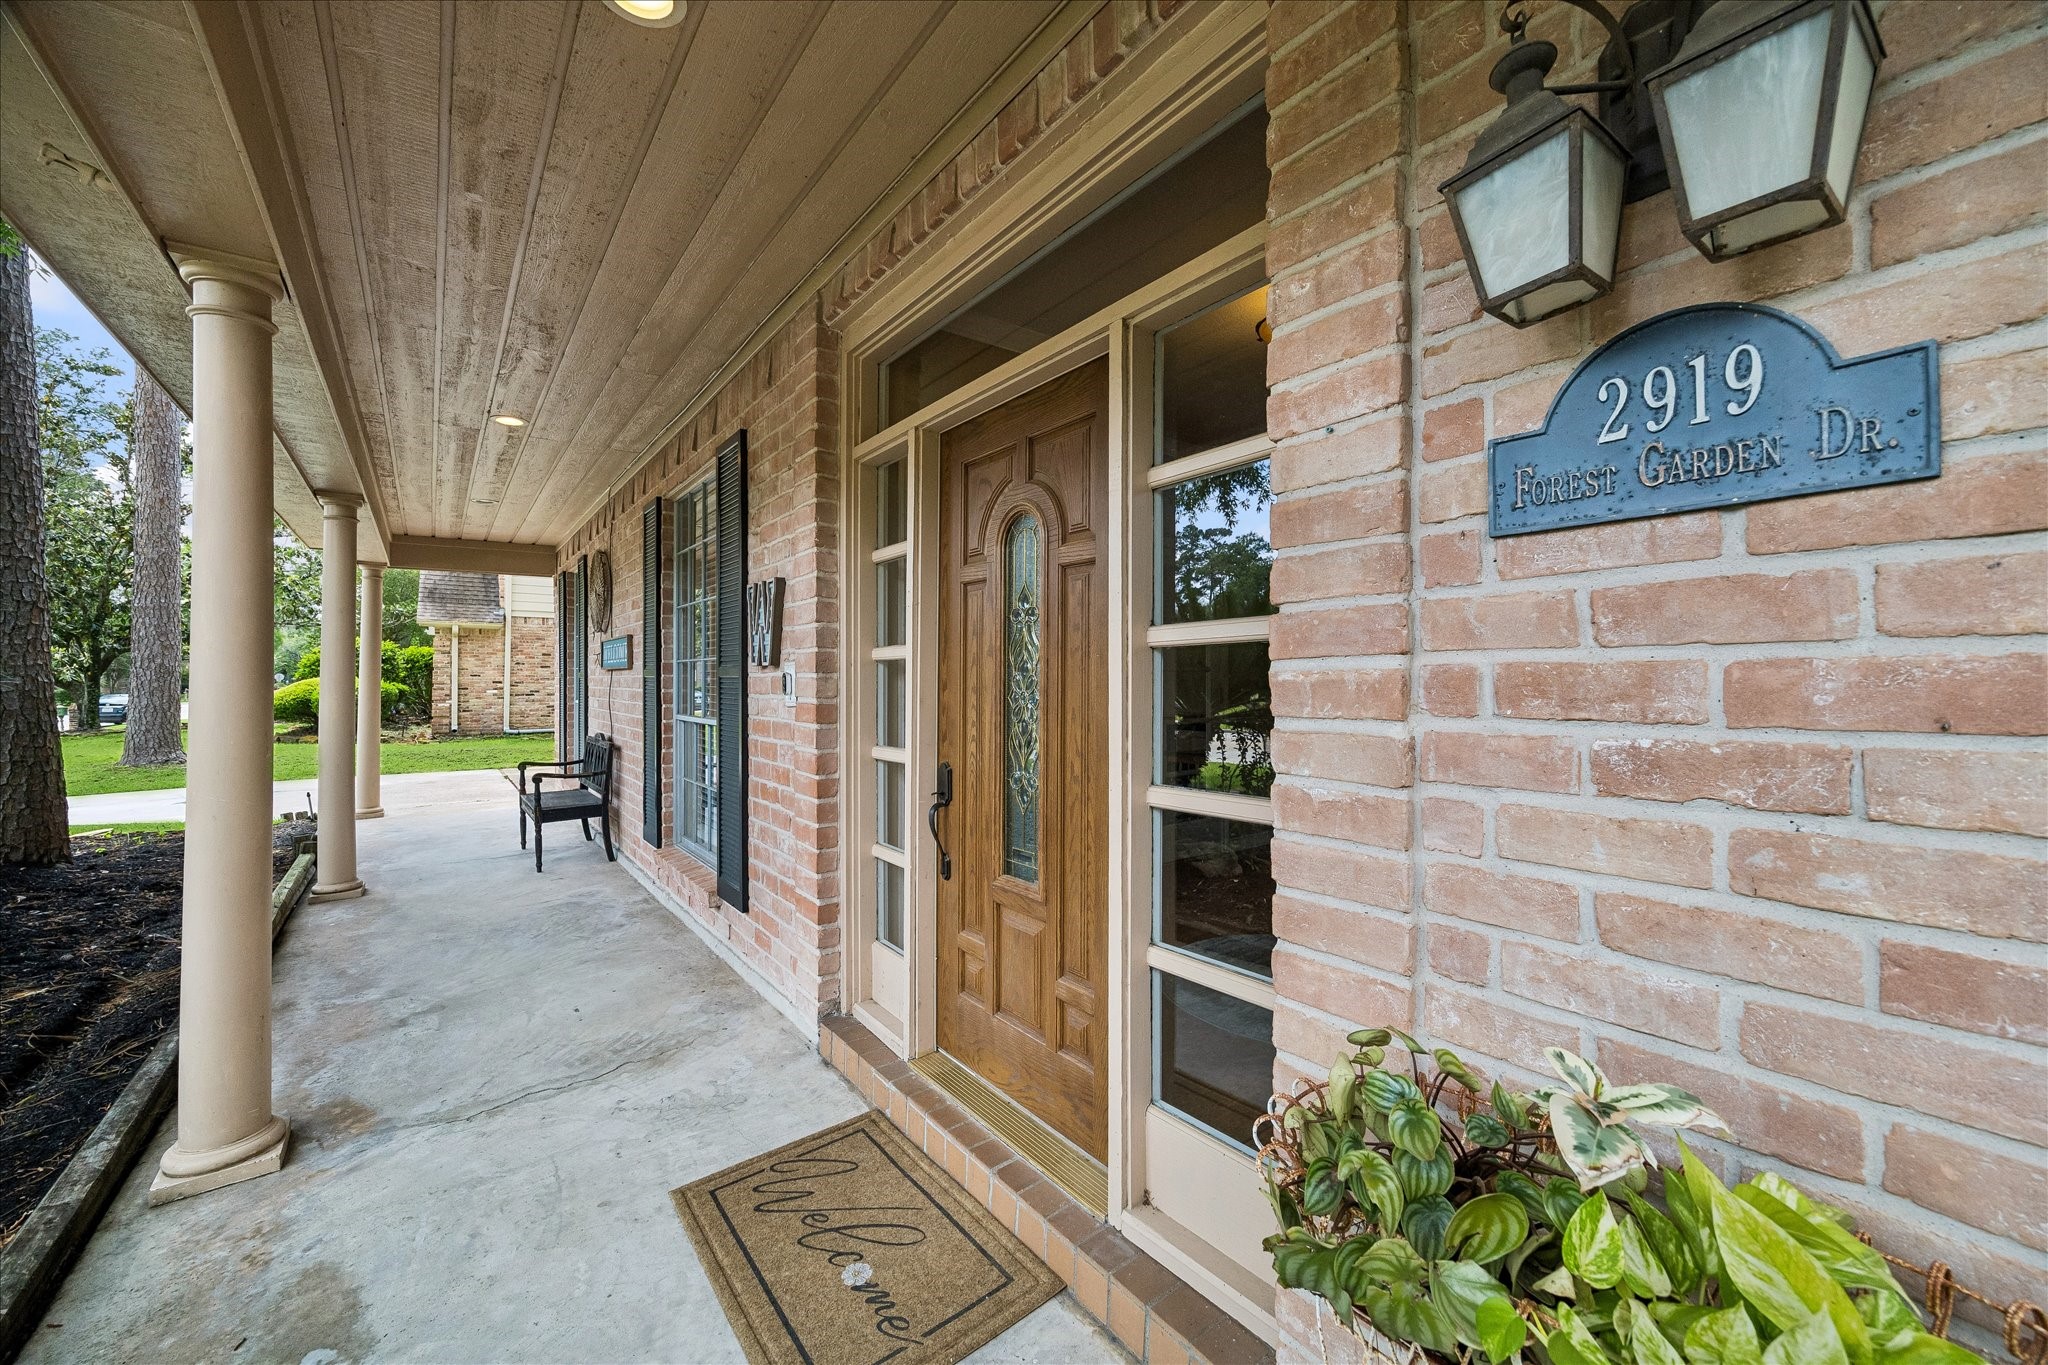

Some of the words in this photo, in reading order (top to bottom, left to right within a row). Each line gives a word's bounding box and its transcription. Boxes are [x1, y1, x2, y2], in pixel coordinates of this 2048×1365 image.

[1597, 344, 1764, 445] 2919
[1514, 465, 1617, 509] FOREST
[1638, 434, 1784, 488] GARDEN
[747, 577, 779, 666] W
